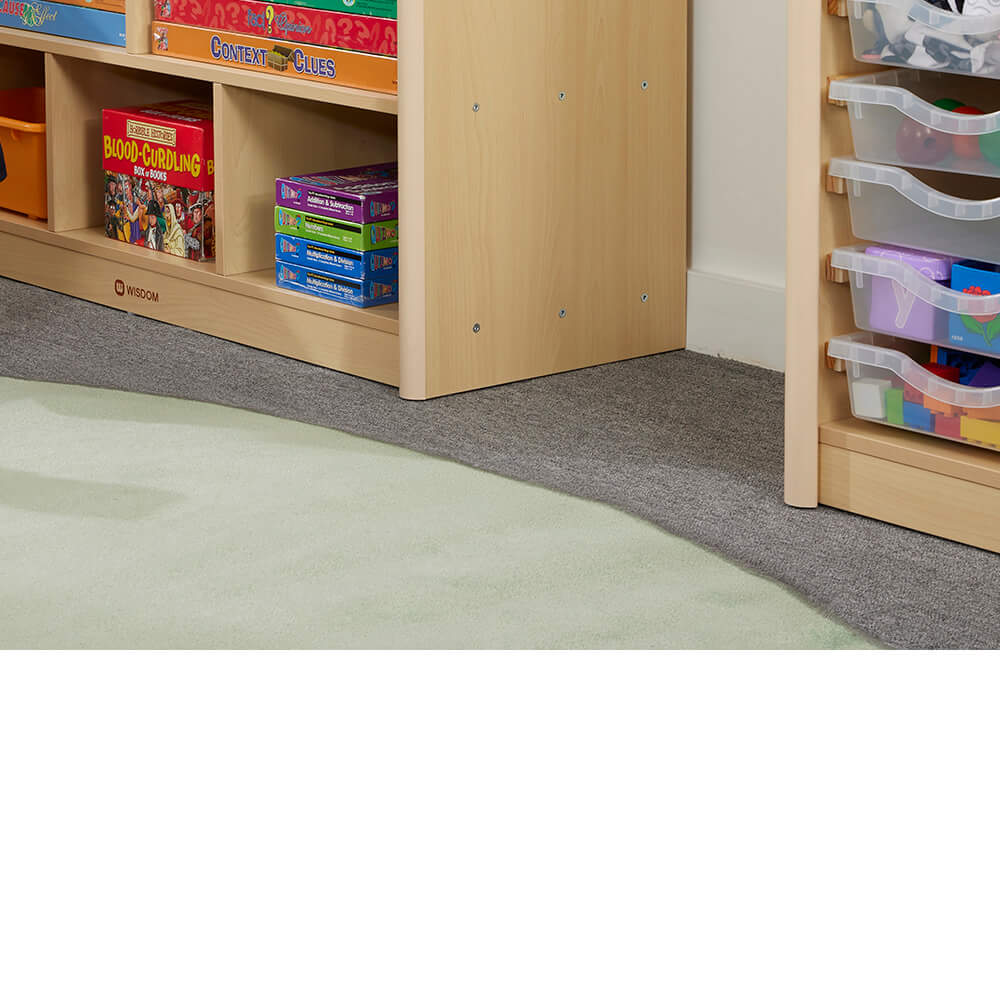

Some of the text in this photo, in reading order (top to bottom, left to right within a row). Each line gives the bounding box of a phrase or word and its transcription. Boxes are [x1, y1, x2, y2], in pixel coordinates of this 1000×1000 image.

[210, 34, 337, 79] CONTEXT CLUES
[103, 135, 201, 178] BLOOD-CURDLING
[134, 165, 145, 177] BOX
[149, 169, 167, 182] BOOKS
[126, 284, 160, 303] WISDOM
